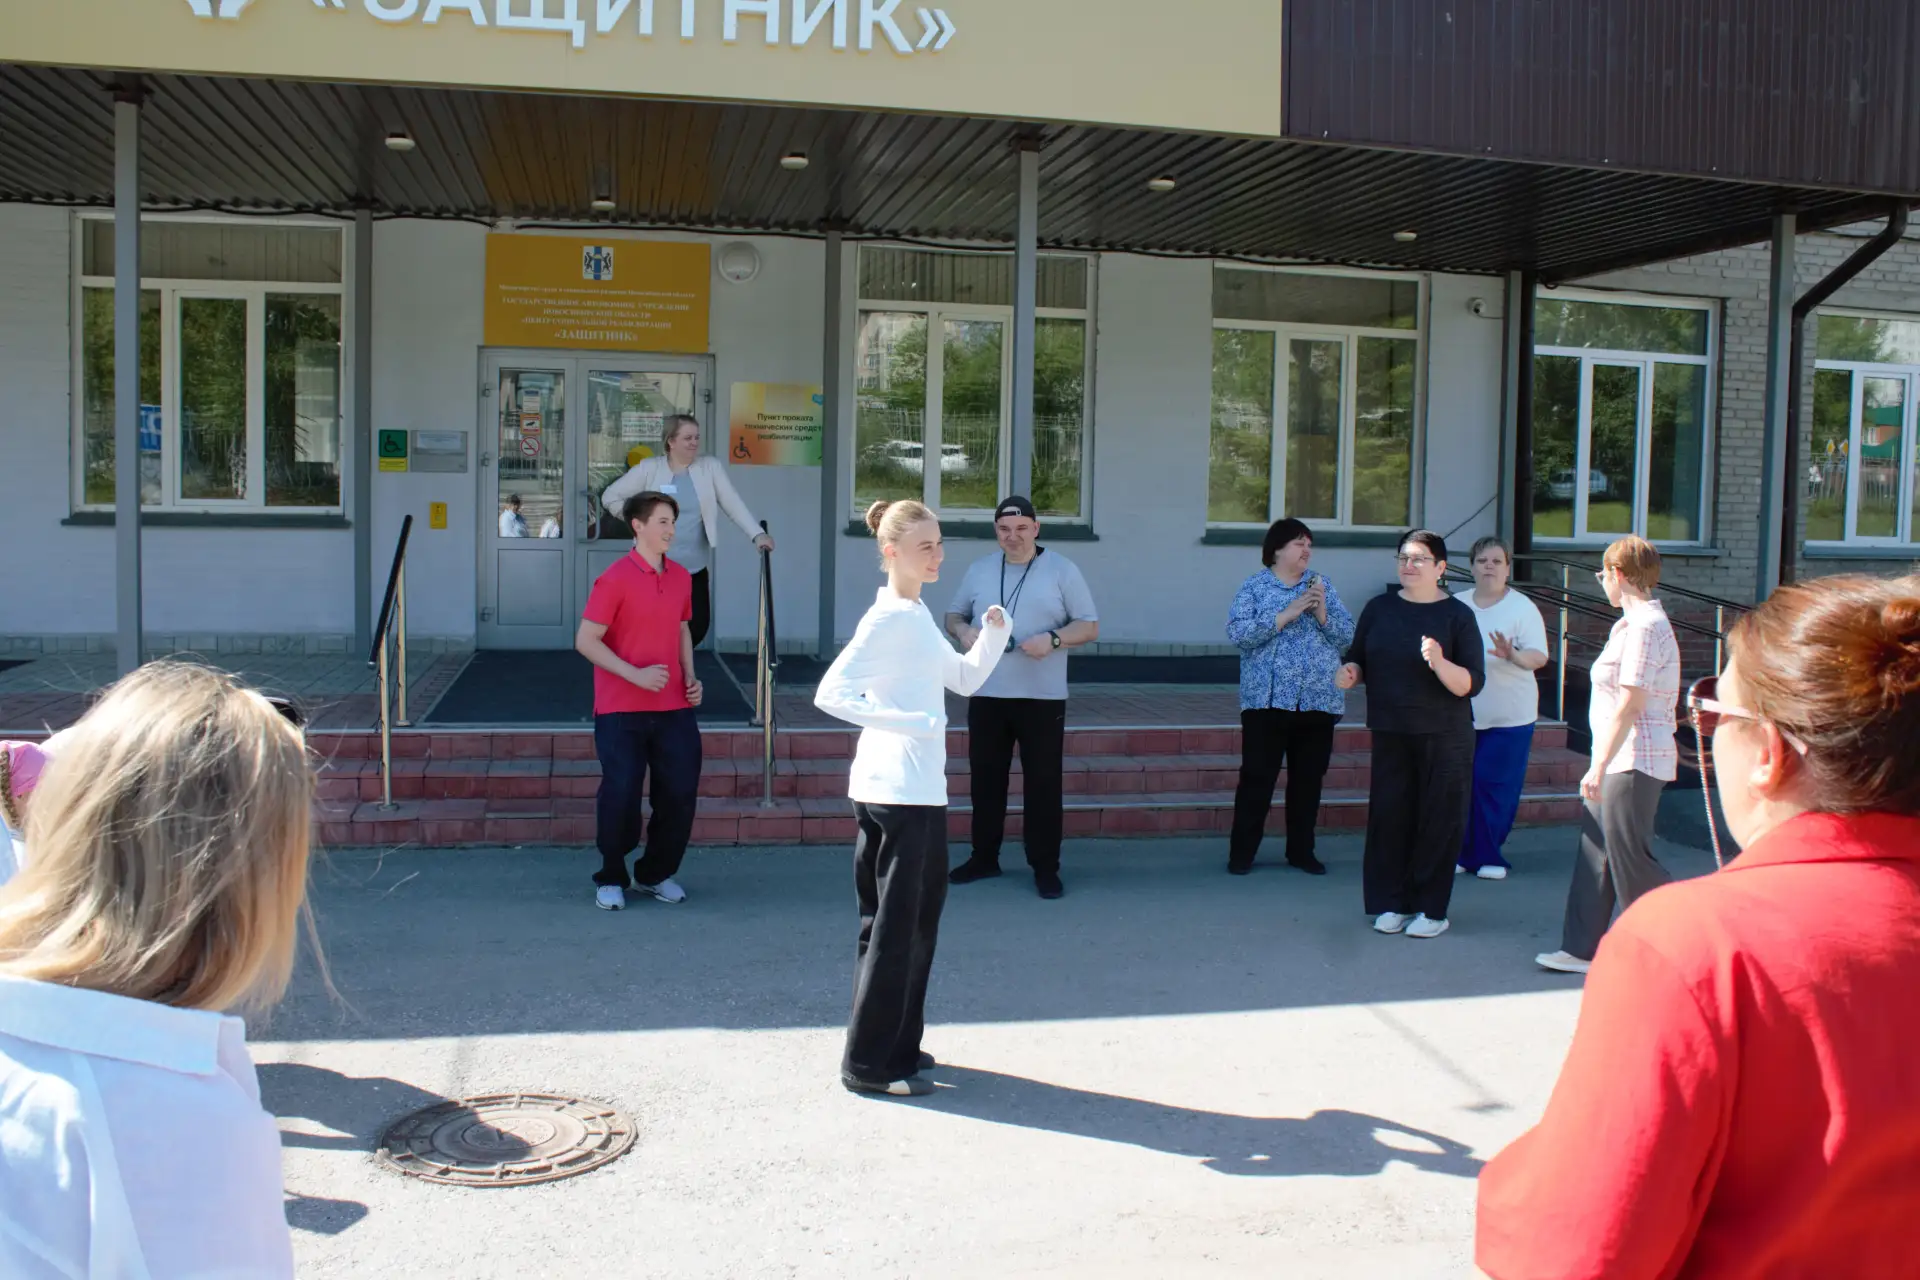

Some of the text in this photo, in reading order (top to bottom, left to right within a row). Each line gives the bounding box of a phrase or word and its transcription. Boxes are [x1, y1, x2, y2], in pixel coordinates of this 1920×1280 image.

[301, 0, 957, 52] ЩИТНИК»
[757, 413, 780, 422] Пункт
[744, 423, 823, 433] технических средст
